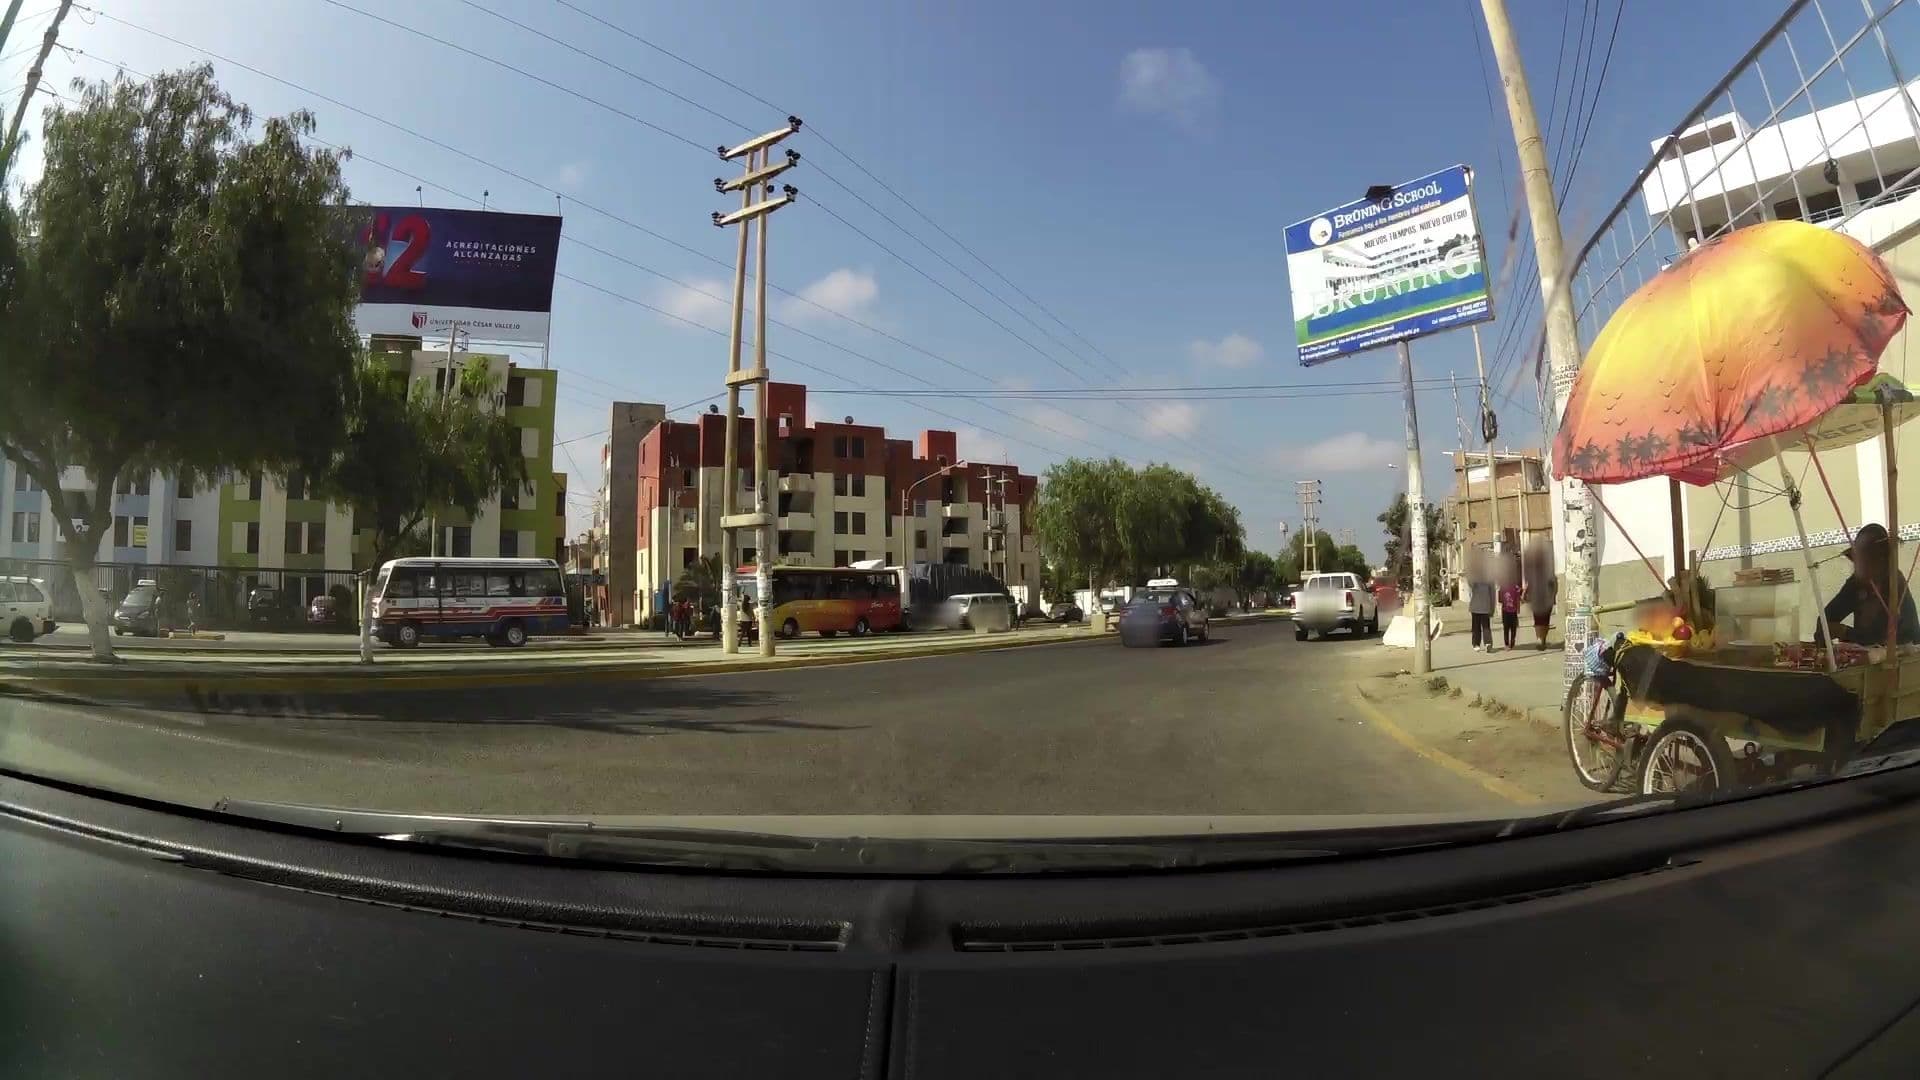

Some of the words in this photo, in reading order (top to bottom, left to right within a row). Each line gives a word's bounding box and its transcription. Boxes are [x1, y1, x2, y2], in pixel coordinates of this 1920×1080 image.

[446, 241, 536, 254] ACREDITACIONES
[453, 250, 522, 262] ALCANZADAS
[429, 319, 471, 328] UNIVERIDAD
[494, 322, 520, 330] VALLEJO
